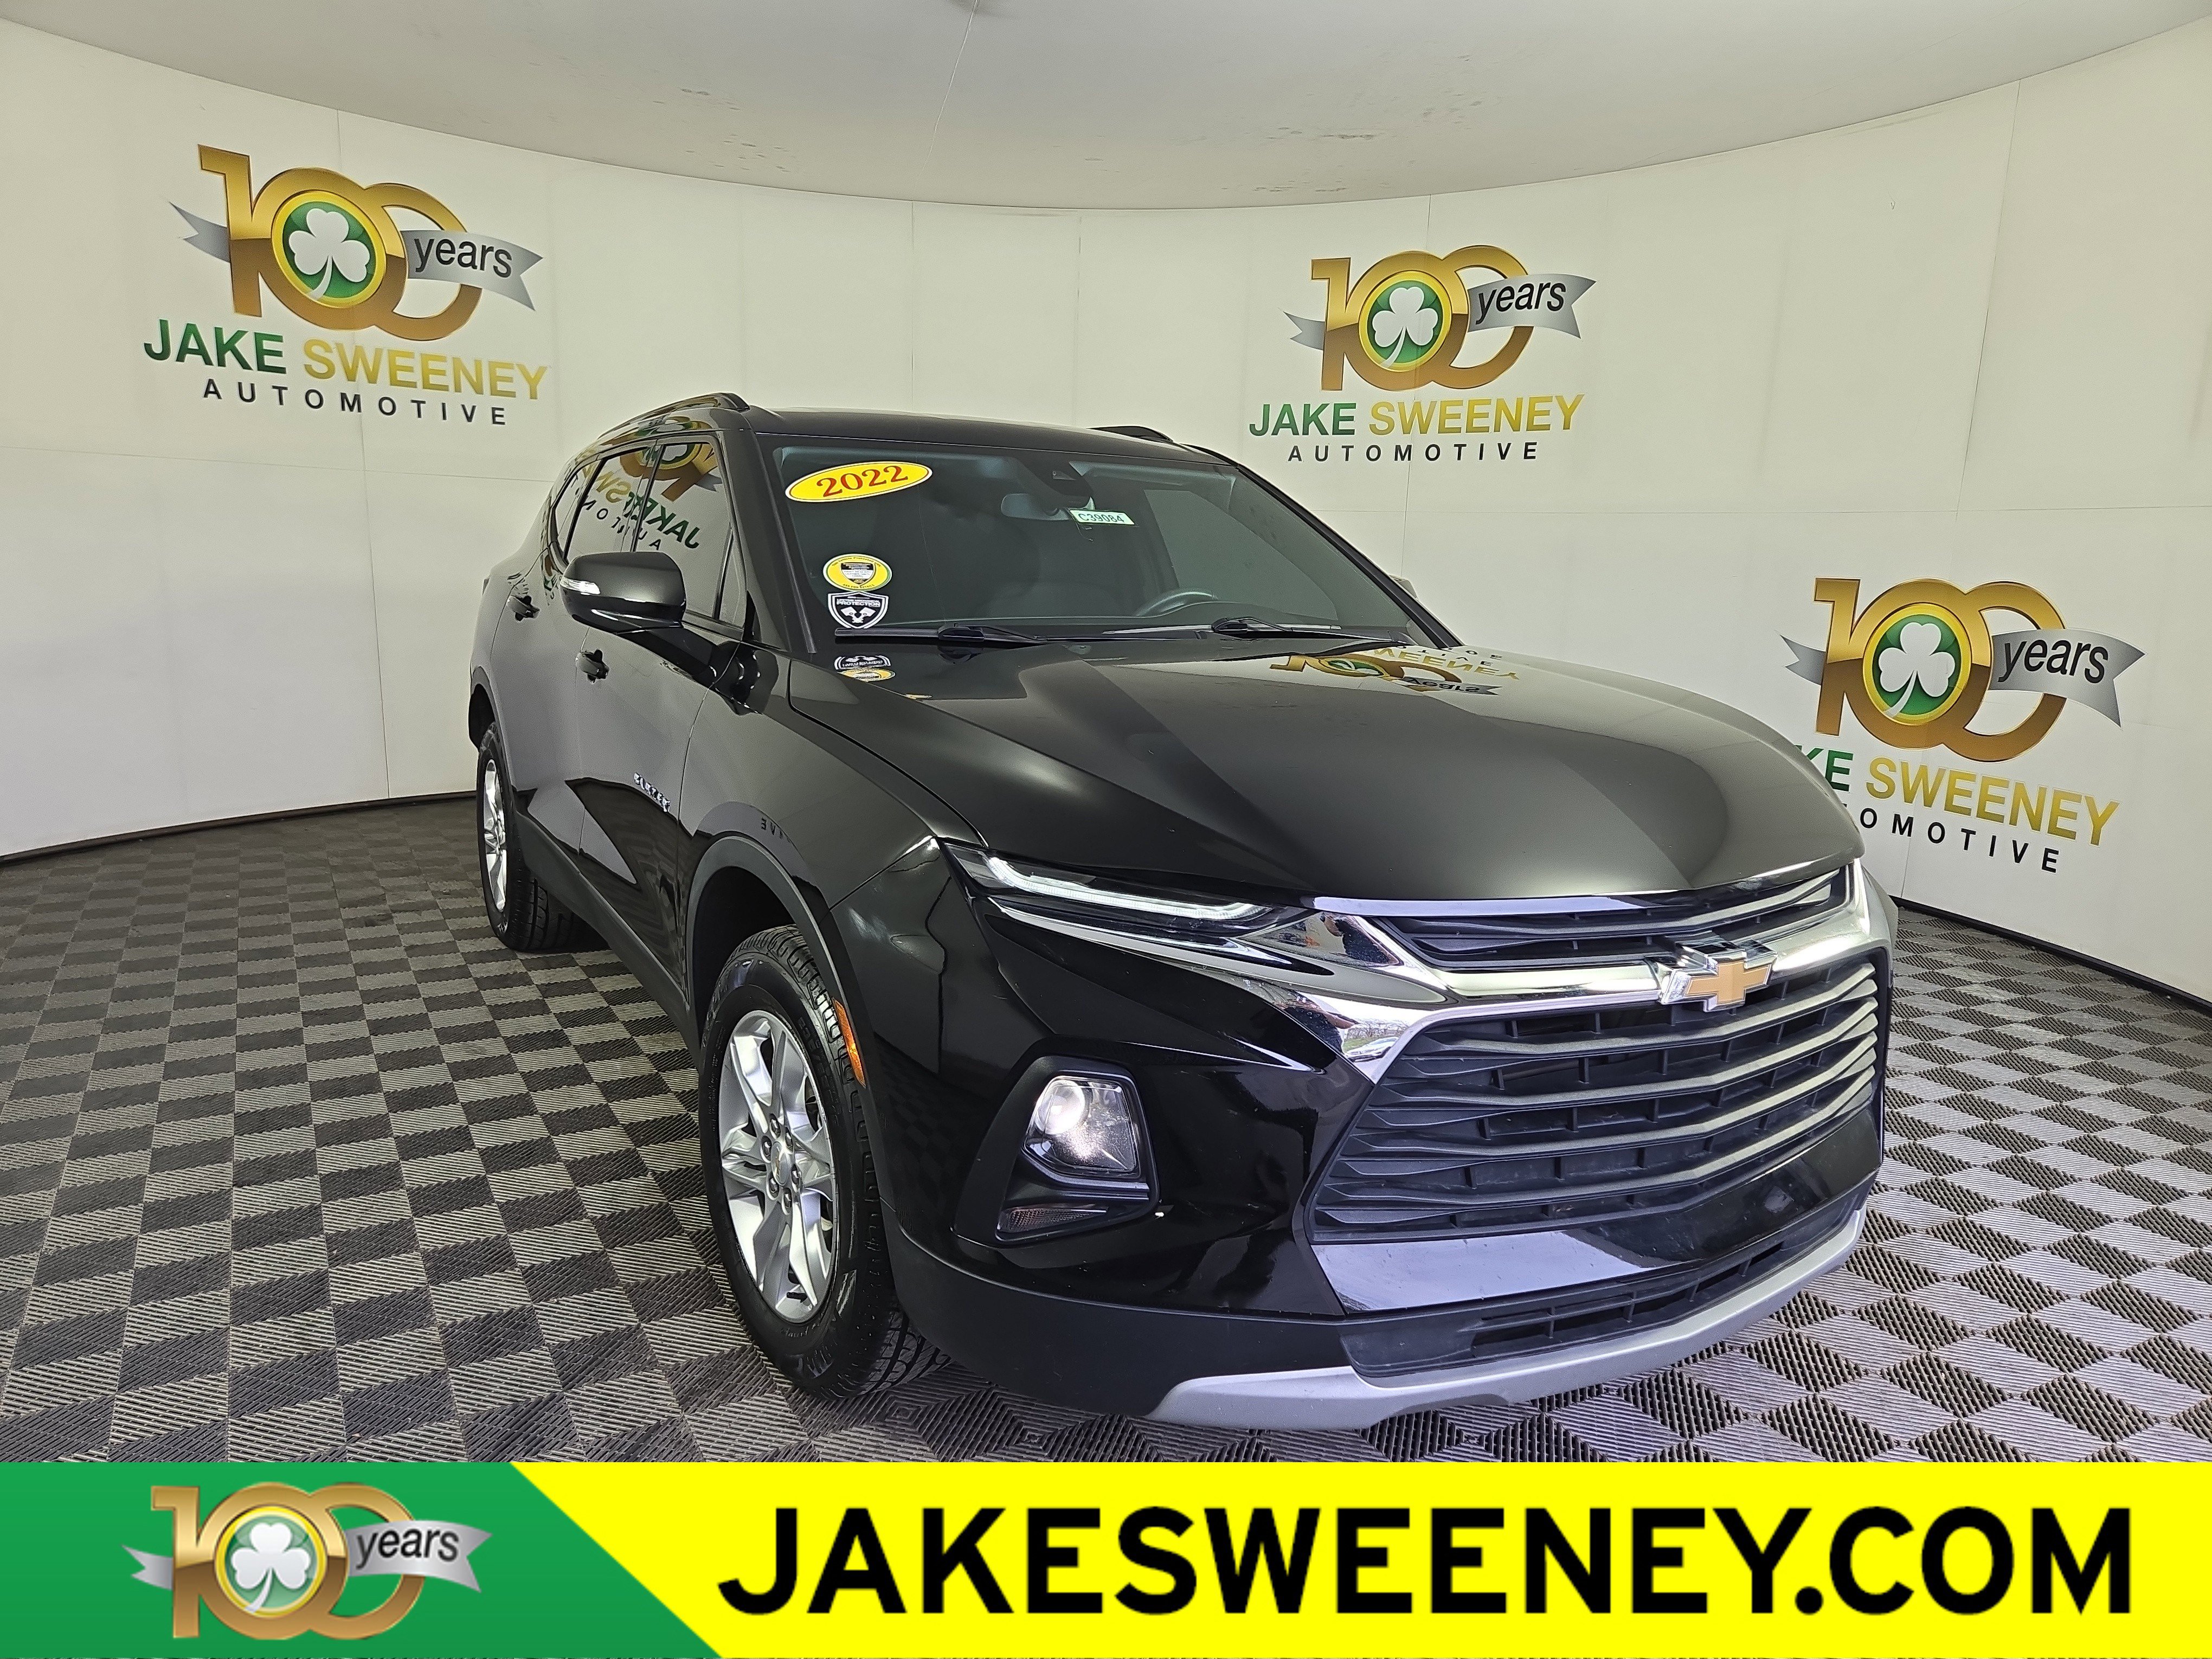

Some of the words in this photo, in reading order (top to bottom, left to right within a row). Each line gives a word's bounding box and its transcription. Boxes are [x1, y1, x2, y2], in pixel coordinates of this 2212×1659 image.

[197, 144, 483, 341] 100
[414, 236, 513, 279] years
[1311, 245, 1534, 392] 100
[1475, 280, 1566, 325] years
[143, 319, 287, 375] JAKE
[303, 339, 549, 401] SWEENEY
[203, 378, 506, 426] AUTOMOTIVE
[1249, 403, 1356, 436] JAKE
[1369, 394, 1584, 435] SWEENEY
[1288, 441, 1538, 462] AUTOMOTIVE
[816, 465, 909, 498] 2022
[1078, 513, 1125, 523] C39084
[1814, 577, 2067, 762] 100
[1997, 639, 2109, 684] years
[634, 772, 671, 812] BLAZER
[1866, 757, 2120, 847] SWEENEY
[1842, 803, 2060, 873] OMOTIVE
